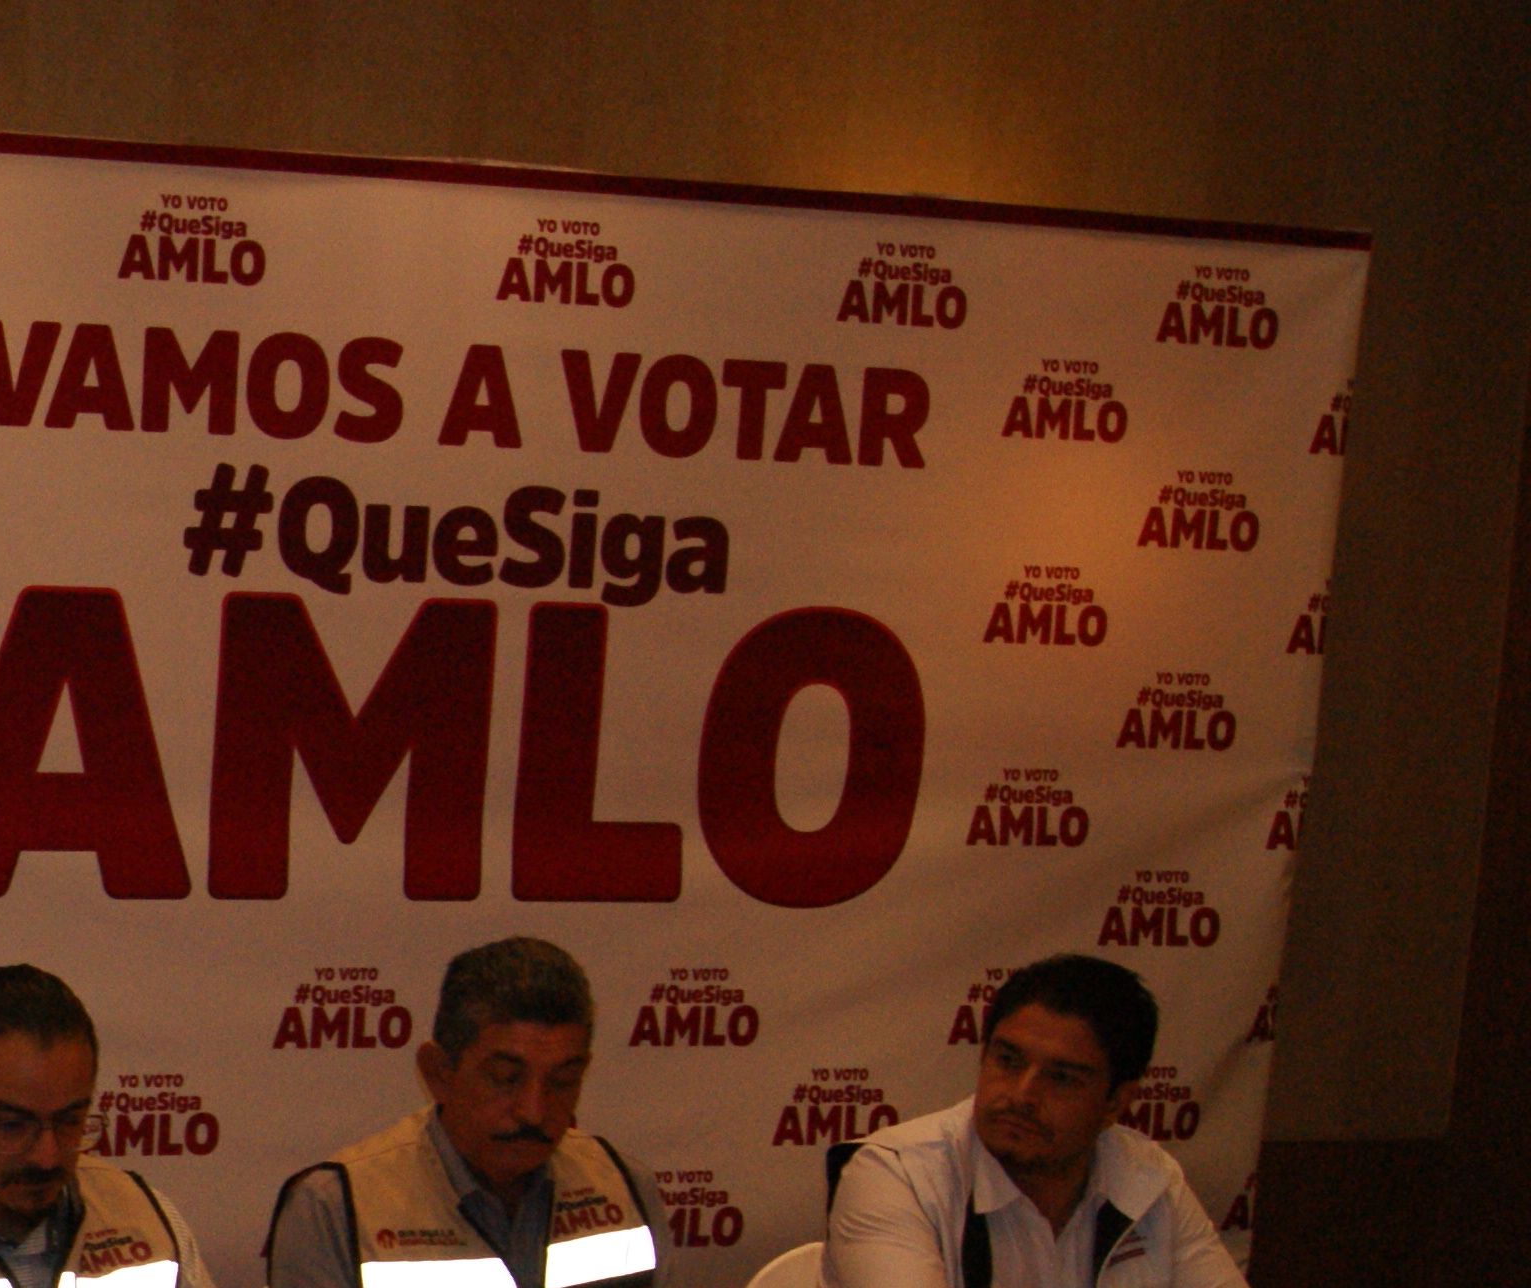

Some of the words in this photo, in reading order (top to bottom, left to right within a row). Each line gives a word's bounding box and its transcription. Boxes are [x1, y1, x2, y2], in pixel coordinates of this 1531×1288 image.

[538, 219, 557, 233] YO
[562, 221, 600, 236] VOTO
[517, 235, 618, 264] #QueSiga
[495, 257, 635, 309] AMLO
[1195, 266, 1212, 279] YO
[1216, 268, 1250, 282] VOTO
[1176, 280, 1265, 308] #QueSiga
[1155, 301, 1279, 350] AMLO
[437, 344, 522, 449] A
[560, 349, 930, 469] VOTAR
[1177, 470, 1195, 484] YO
[1198, 472, 1233, 486] VOTO
[1158, 485, 1247, 511] #QueSiga
[183, 462, 729, 607] #QueSiga
[1137, 506, 1260, 553] AMLO
[1003, 768, 1021, 782] YO
[1024, 768, 1059, 782] VOTO
[984, 783, 1073, 807] #QueSiga
[965, 805, 1089, 848] AMLO
[670, 968, 689, 981] YO
[692, 968, 729, 981] VOTO
[650, 984, 744, 1007] #QueSiga
[628, 1005, 760, 1047] AMLO
[812, 1067, 829, 1082] YO
[834, 1067, 869, 1081] VOTO
[793, 1084, 884, 1106] #QueSiga
[551, 1203, 624, 1238] AMLO
